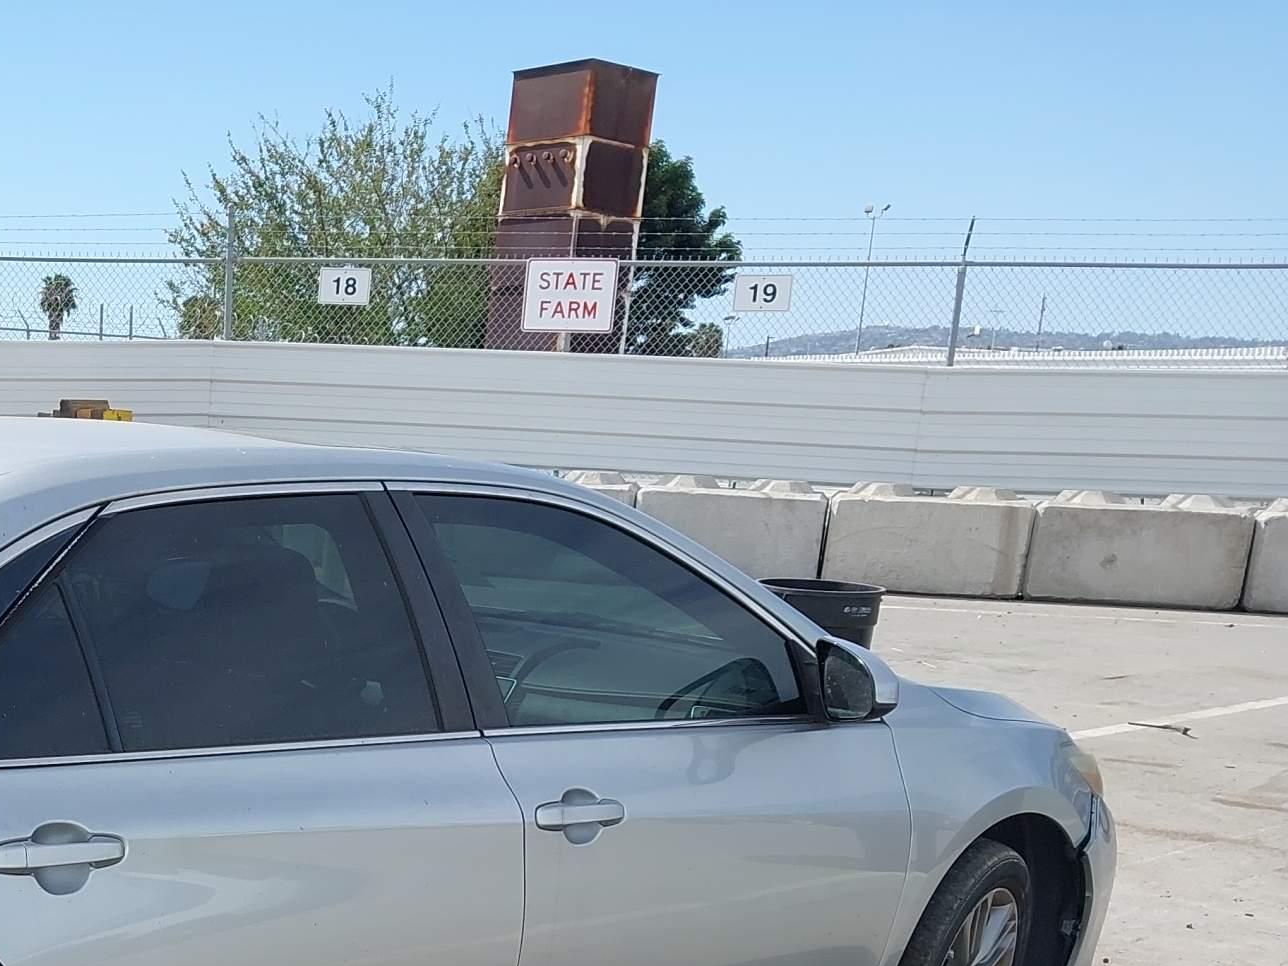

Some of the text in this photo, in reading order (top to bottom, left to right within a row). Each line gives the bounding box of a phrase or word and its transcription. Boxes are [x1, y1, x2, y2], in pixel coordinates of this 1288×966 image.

[332, 276, 358, 296] 18
[539, 271, 604, 291] STATE
[749, 283, 778, 304] 19
[539, 300, 599, 319] FARM
